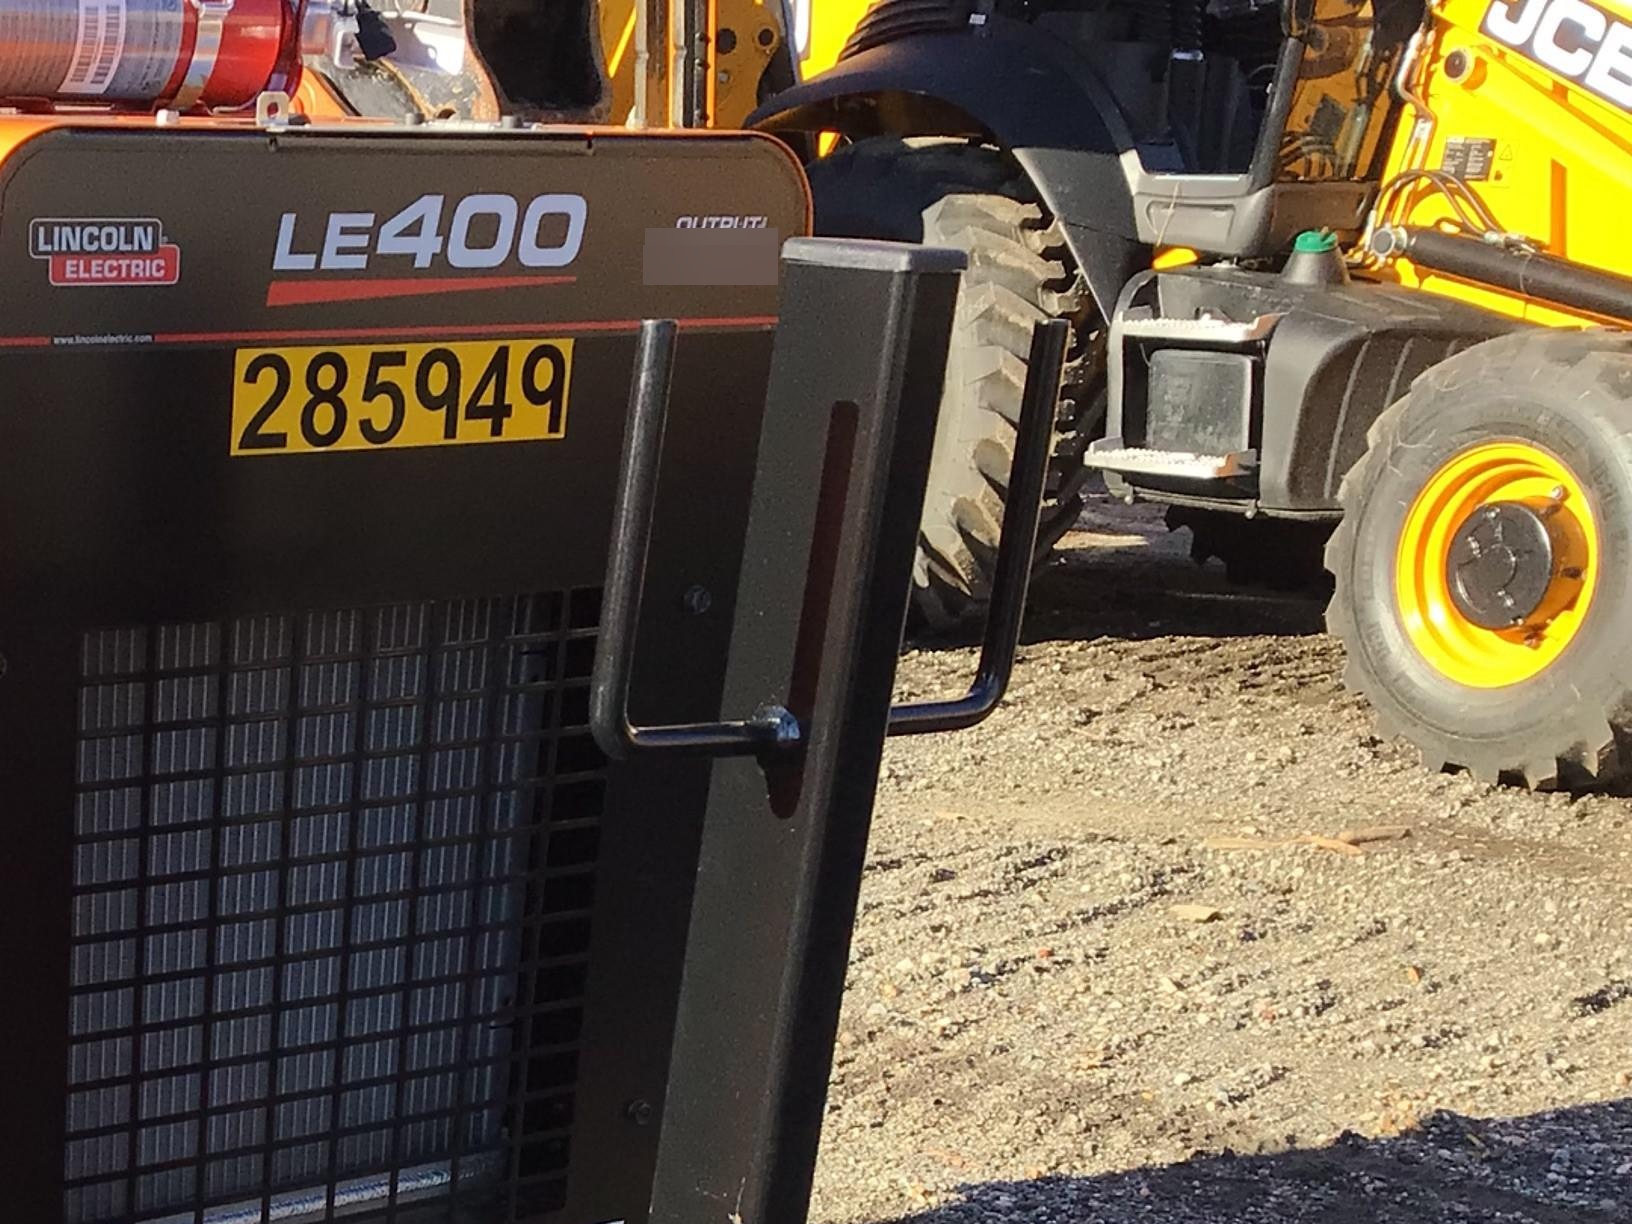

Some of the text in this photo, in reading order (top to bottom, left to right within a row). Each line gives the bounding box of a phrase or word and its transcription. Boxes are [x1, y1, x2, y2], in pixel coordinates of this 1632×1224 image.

[38, 226, 153, 251] LINCOLN
[272, 193, 587, 270] LE400
[65, 259, 165, 278] ELECTRIC
[237, 343, 566, 451] 285949
